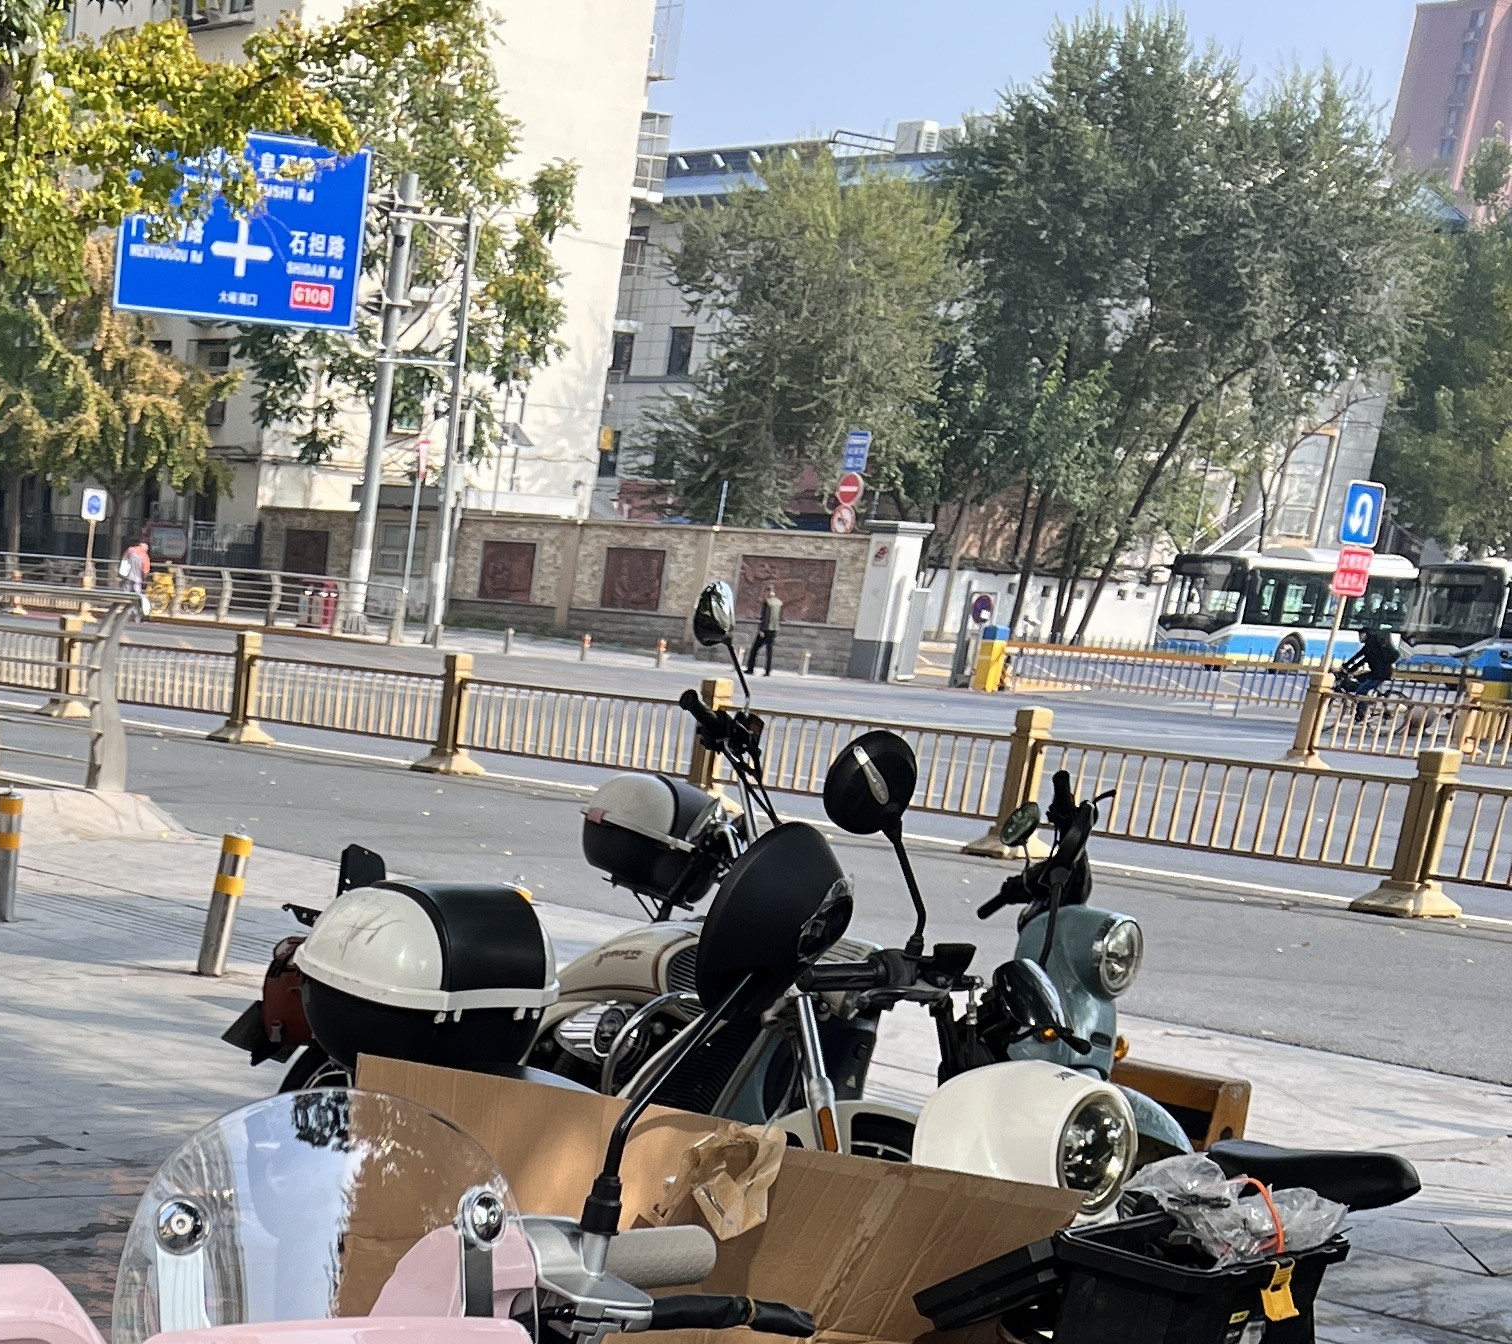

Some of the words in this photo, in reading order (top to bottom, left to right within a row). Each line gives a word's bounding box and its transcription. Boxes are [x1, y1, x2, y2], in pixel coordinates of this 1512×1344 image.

[289, 230, 346, 260] 石担路
[293, 287, 331, 305] G108
